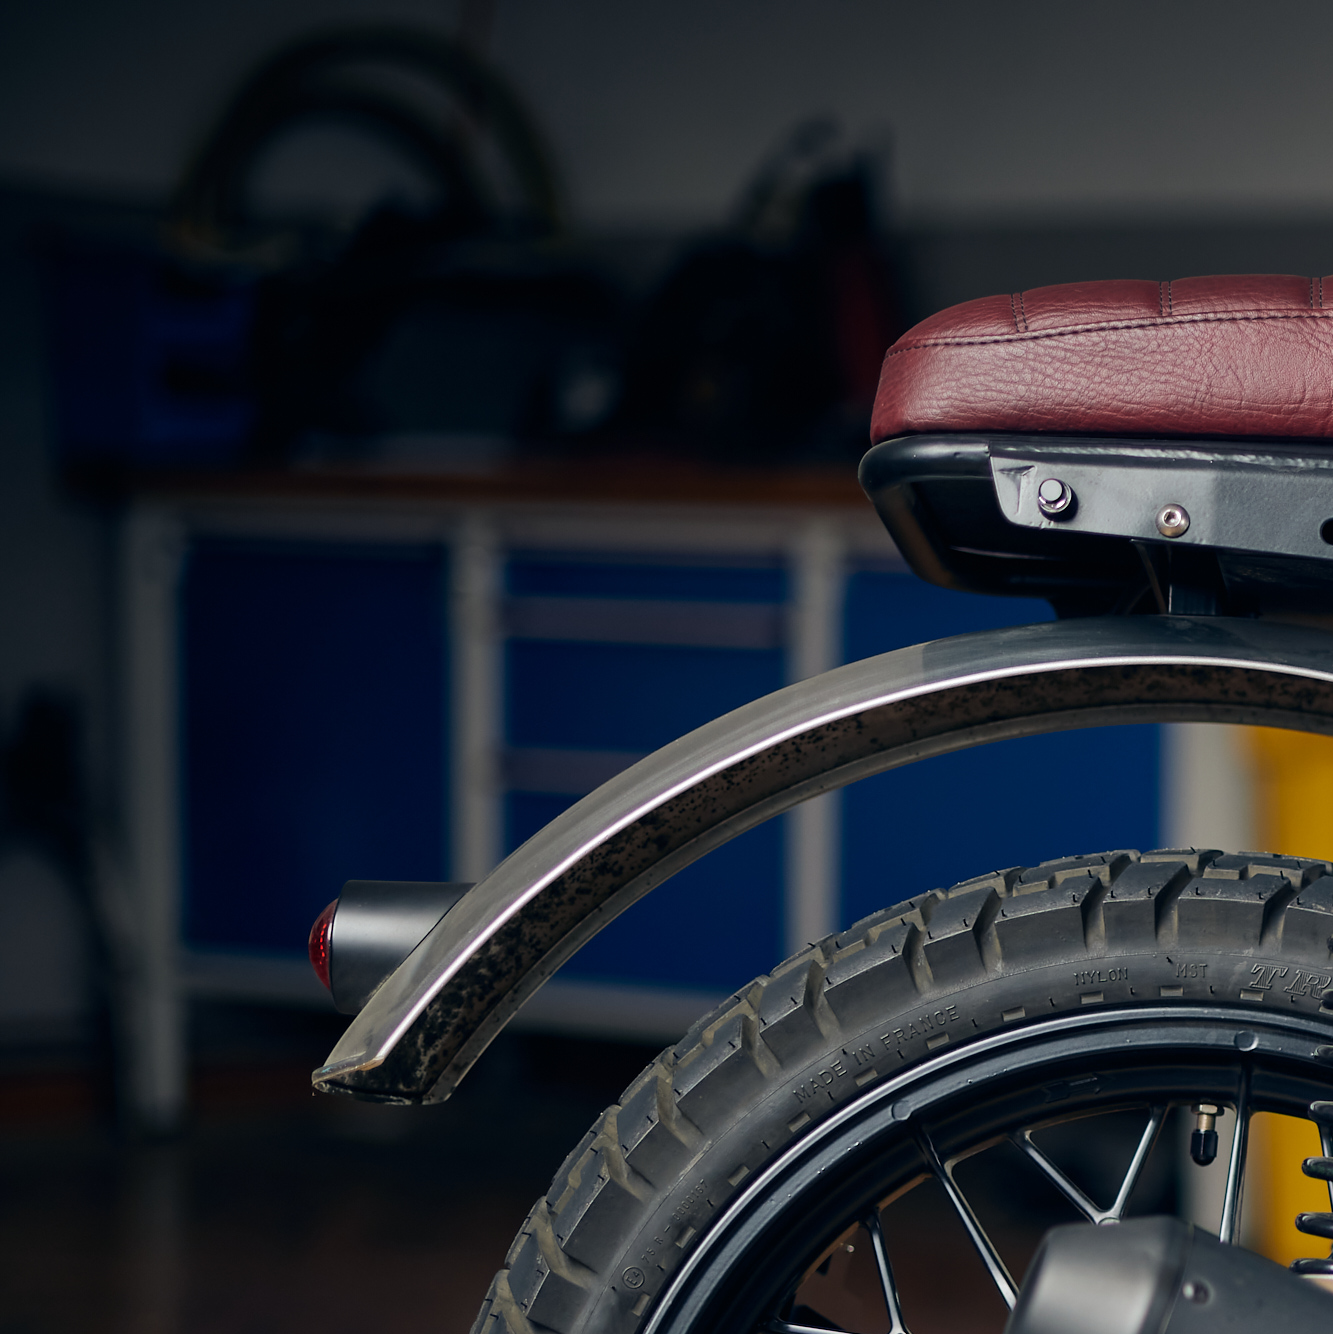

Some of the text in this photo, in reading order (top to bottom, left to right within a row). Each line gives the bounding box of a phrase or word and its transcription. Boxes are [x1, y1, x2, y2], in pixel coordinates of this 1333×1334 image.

[1073, 966, 1129, 986] NYLON
[791, 1003, 961, 1104] MADE IN FRANCE
